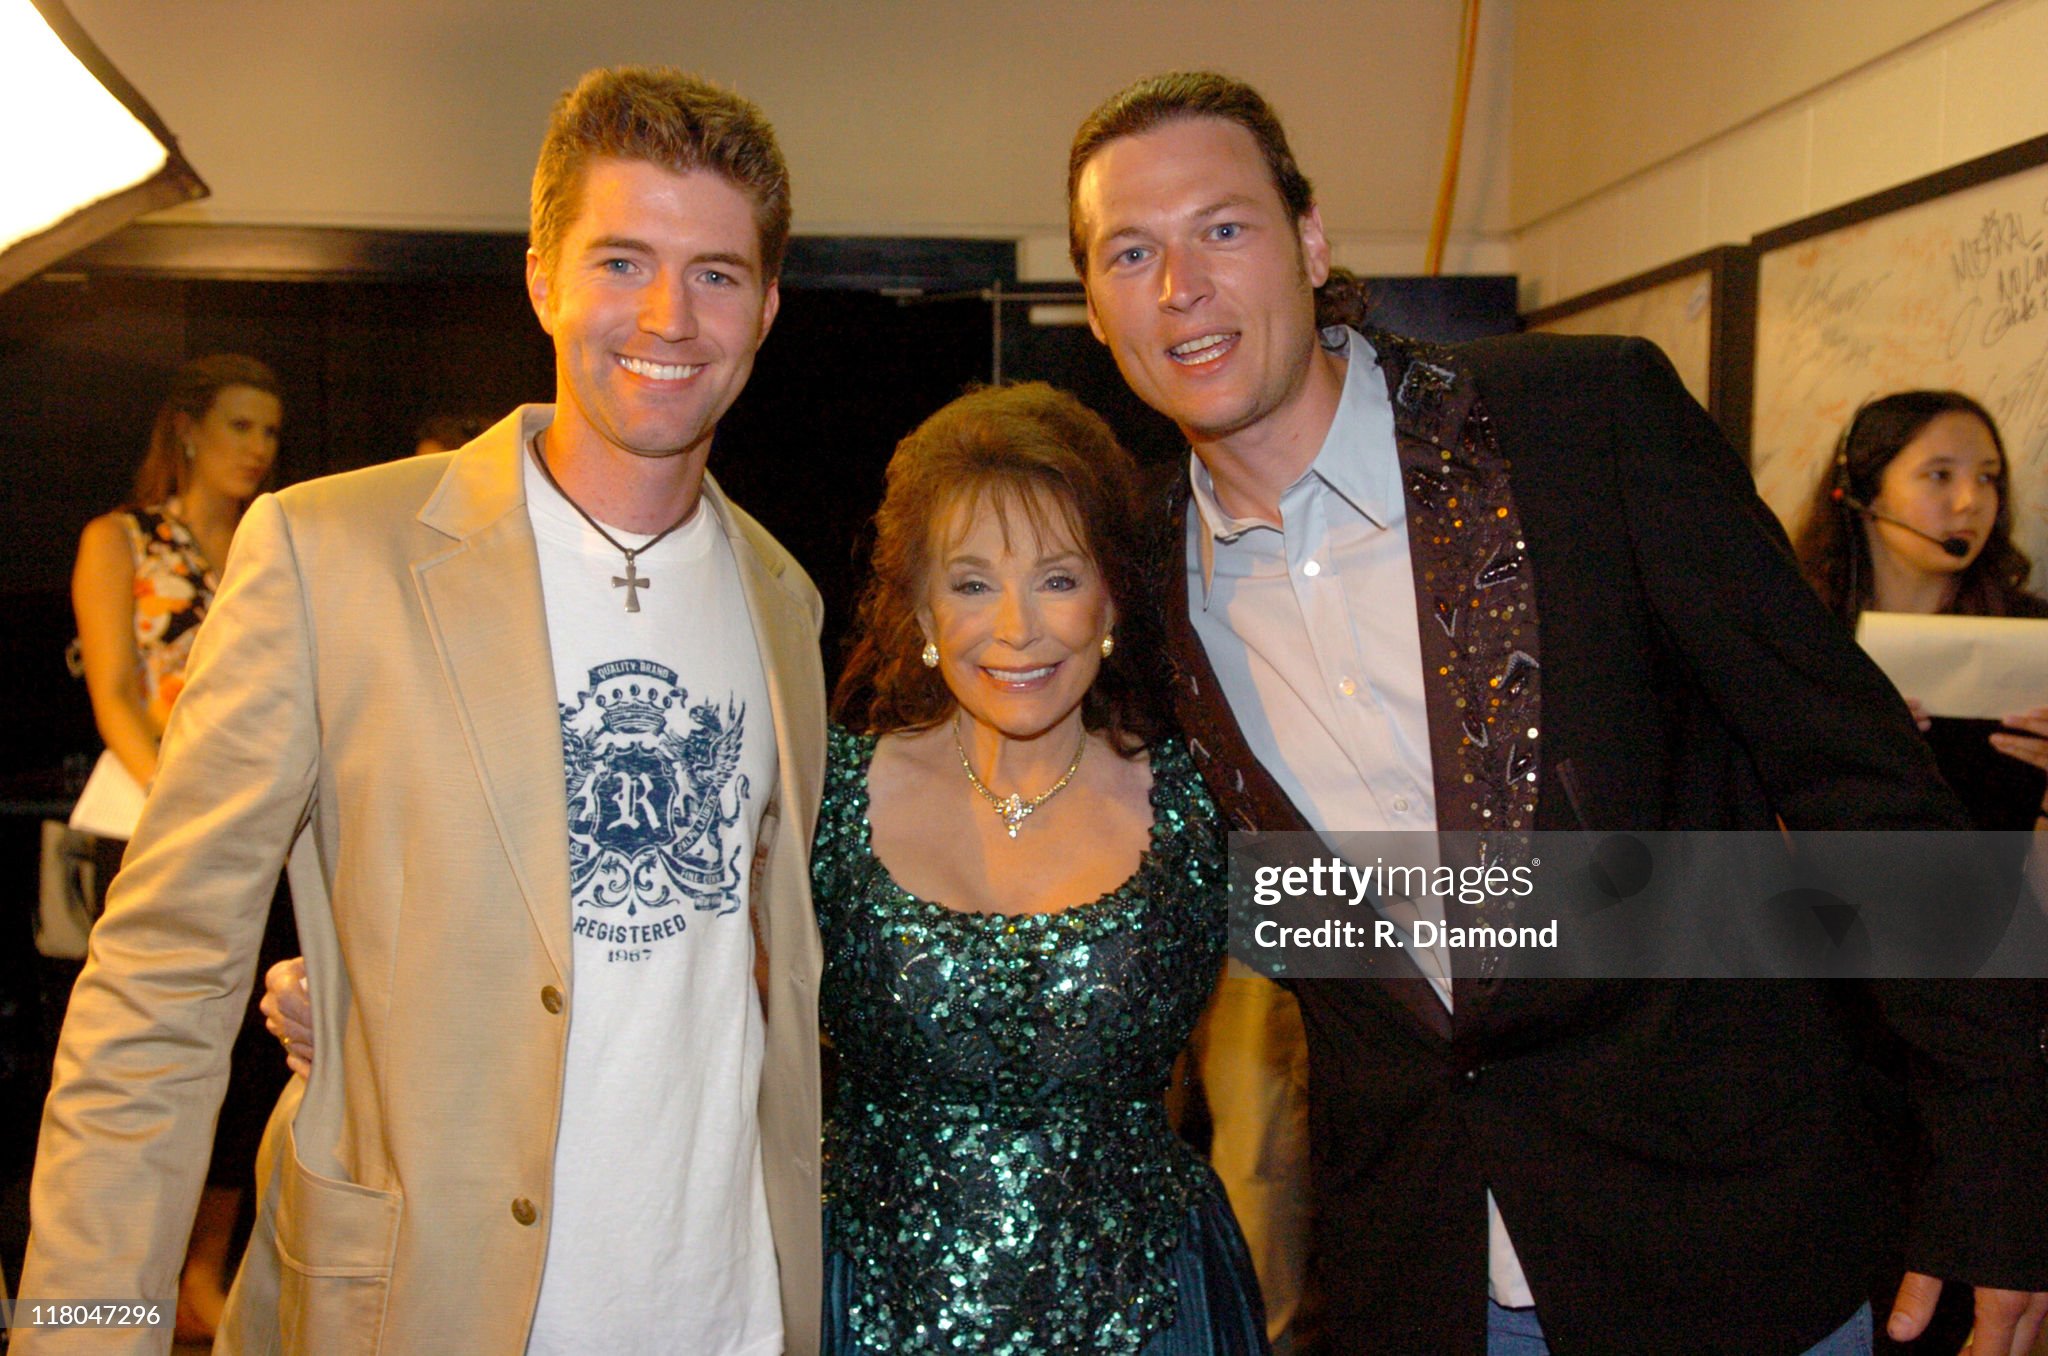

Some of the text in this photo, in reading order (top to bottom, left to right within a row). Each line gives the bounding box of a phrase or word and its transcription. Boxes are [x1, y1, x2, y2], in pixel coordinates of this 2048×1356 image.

[597, 661, 669, 681] QUALITY BRAND
[573, 914, 687, 944] REGISTERED
